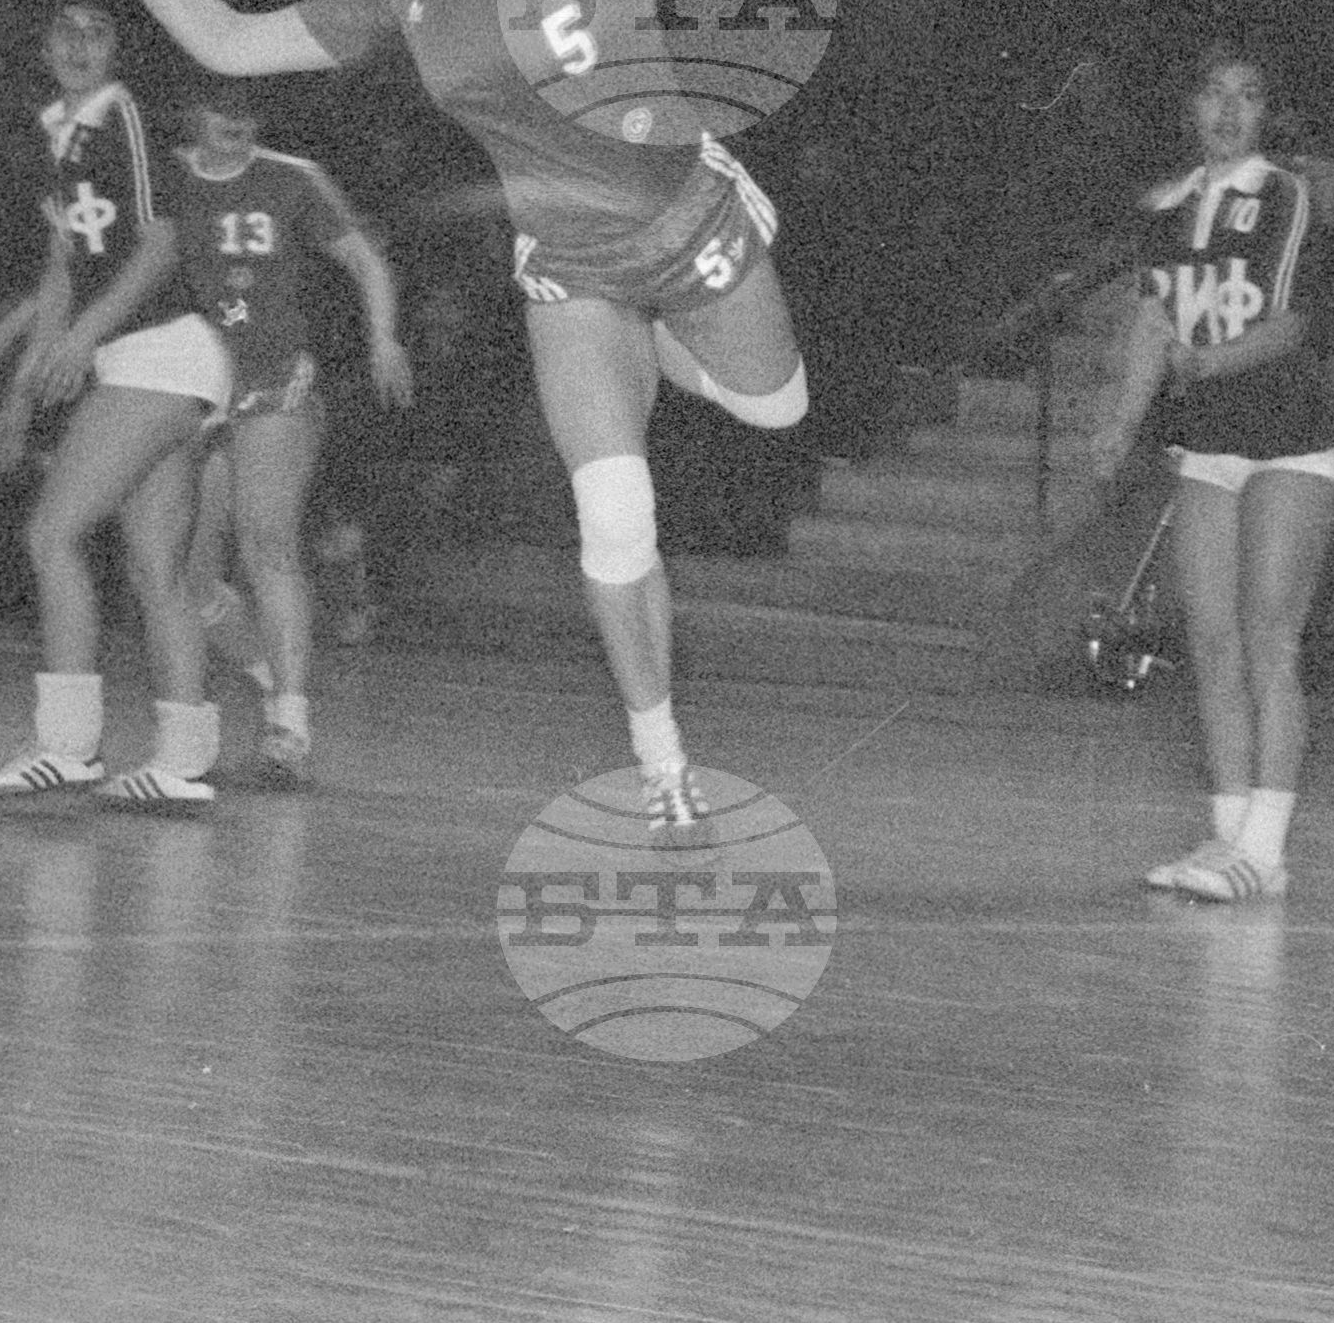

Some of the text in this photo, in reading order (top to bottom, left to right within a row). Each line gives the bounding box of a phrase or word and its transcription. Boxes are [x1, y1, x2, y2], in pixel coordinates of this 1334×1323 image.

[540, 0, 598, 75] 5
[218, 210, 276, 254] 13
[695, 237, 732, 289] 5
